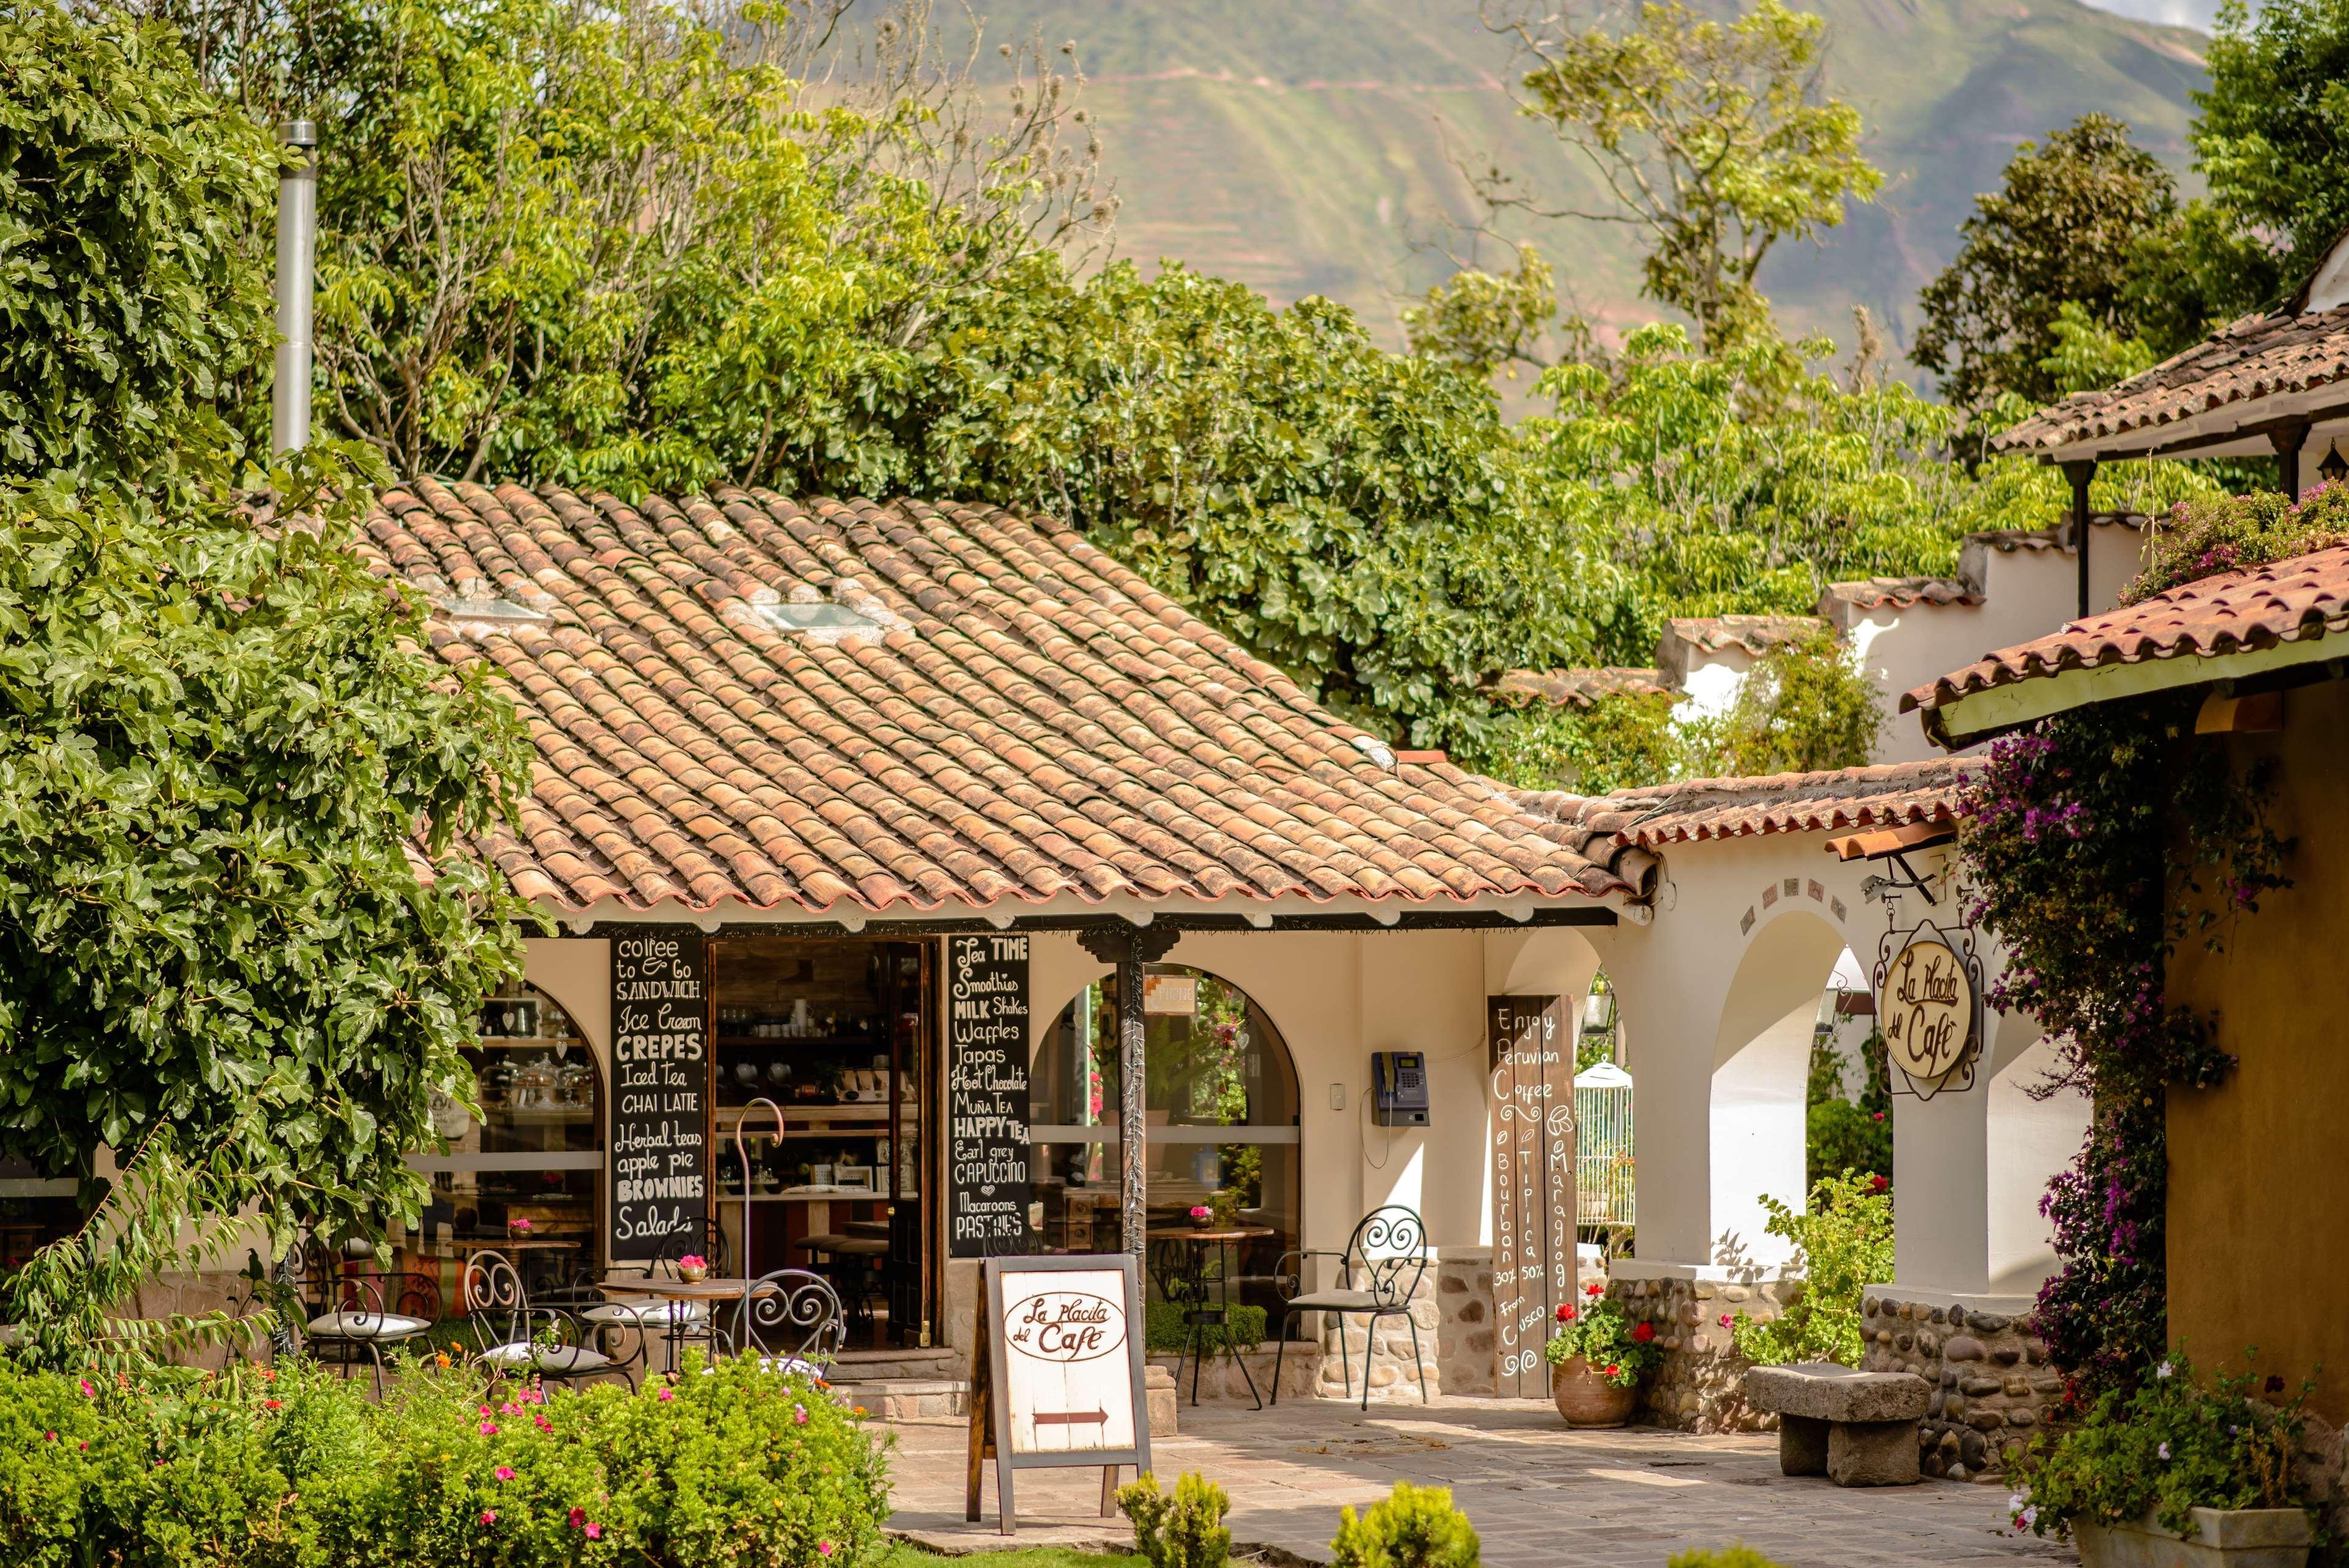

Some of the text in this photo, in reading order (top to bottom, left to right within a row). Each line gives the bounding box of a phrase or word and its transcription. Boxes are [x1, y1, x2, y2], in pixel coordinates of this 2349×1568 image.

[956, 937, 1028, 968] Tea TIME
[616, 959, 691, 978] to Go
[1897, 949, 1916, 1001] La
[616, 981, 701, 1000] SANDWICH
[953, 967, 1018, 999] Smoothies
[1159, 987, 1193, 1001] PHONE
[618, 1003, 702, 1034] Ice Cream
[955, 996, 1028, 1019] MILK Shakes
[955, 1017, 1019, 1044] Waffles
[1498, 1008, 1555, 1039] Enjoy
[1887, 1011, 1903, 1039] del
[617, 1033, 702, 1061] CREPES
[955, 1044, 1006, 1069] Tapas
[1496, 1038, 1559, 1065] Peruvian
[620, 1061, 687, 1087] Iced Tea
[951, 1065, 1027, 1090] Hot Chocolate
[1494, 1069, 1552, 1104] Coffee
[622, 1093, 698, 1113] CHAI LATTE
[615, 1120, 702, 1151] Herbal teas
[954, 1116, 1030, 1144] HAPPY TEA
[617, 1149, 694, 1179] apple pie
[955, 1139, 1013, 1164] Earl grey
[955, 1161, 1026, 1184] CAPUCCINO
[617, 1175, 704, 1203] BROWNIES
[960, 1192, 1017, 1213] Macaroons
[1498, 1153, 1511, 1262] Bourbon
[1519, 1151, 1536, 1257] Tipica
[1494, 1268, 1516, 1286] 30%
[1522, 1264, 1544, 1280] 50%
[1023, 1298, 1109, 1323] La Placita
[1500, 1296, 1525, 1316] From
[1013, 1326, 1030, 1342] del
[1502, 1306, 1544, 1345] Cusco
